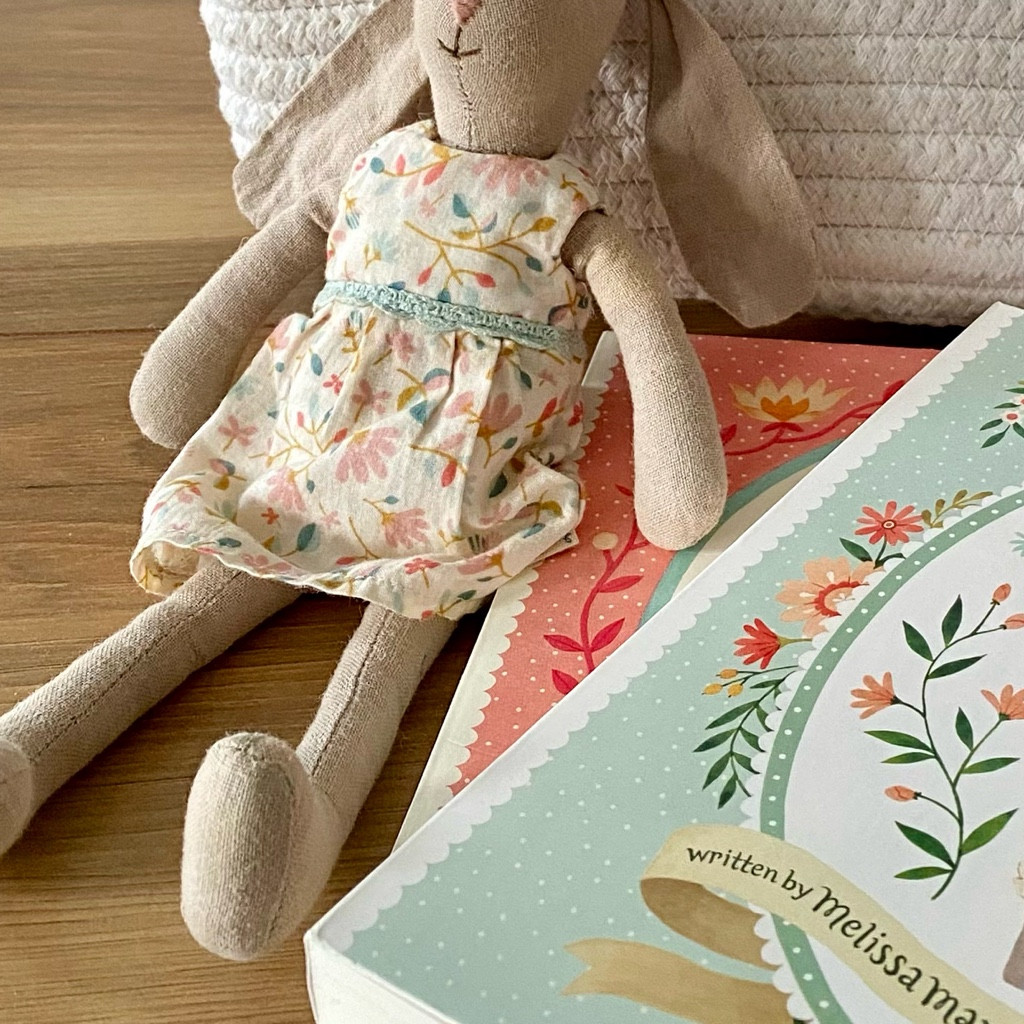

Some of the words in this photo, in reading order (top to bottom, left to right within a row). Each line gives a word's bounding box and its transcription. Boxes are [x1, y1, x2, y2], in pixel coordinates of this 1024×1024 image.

[686, 847, 779, 883] written
[781, 869, 815, 901] by
[812, 886, 924, 993] Melissa
[921, 976, 991, 1024] Ma
